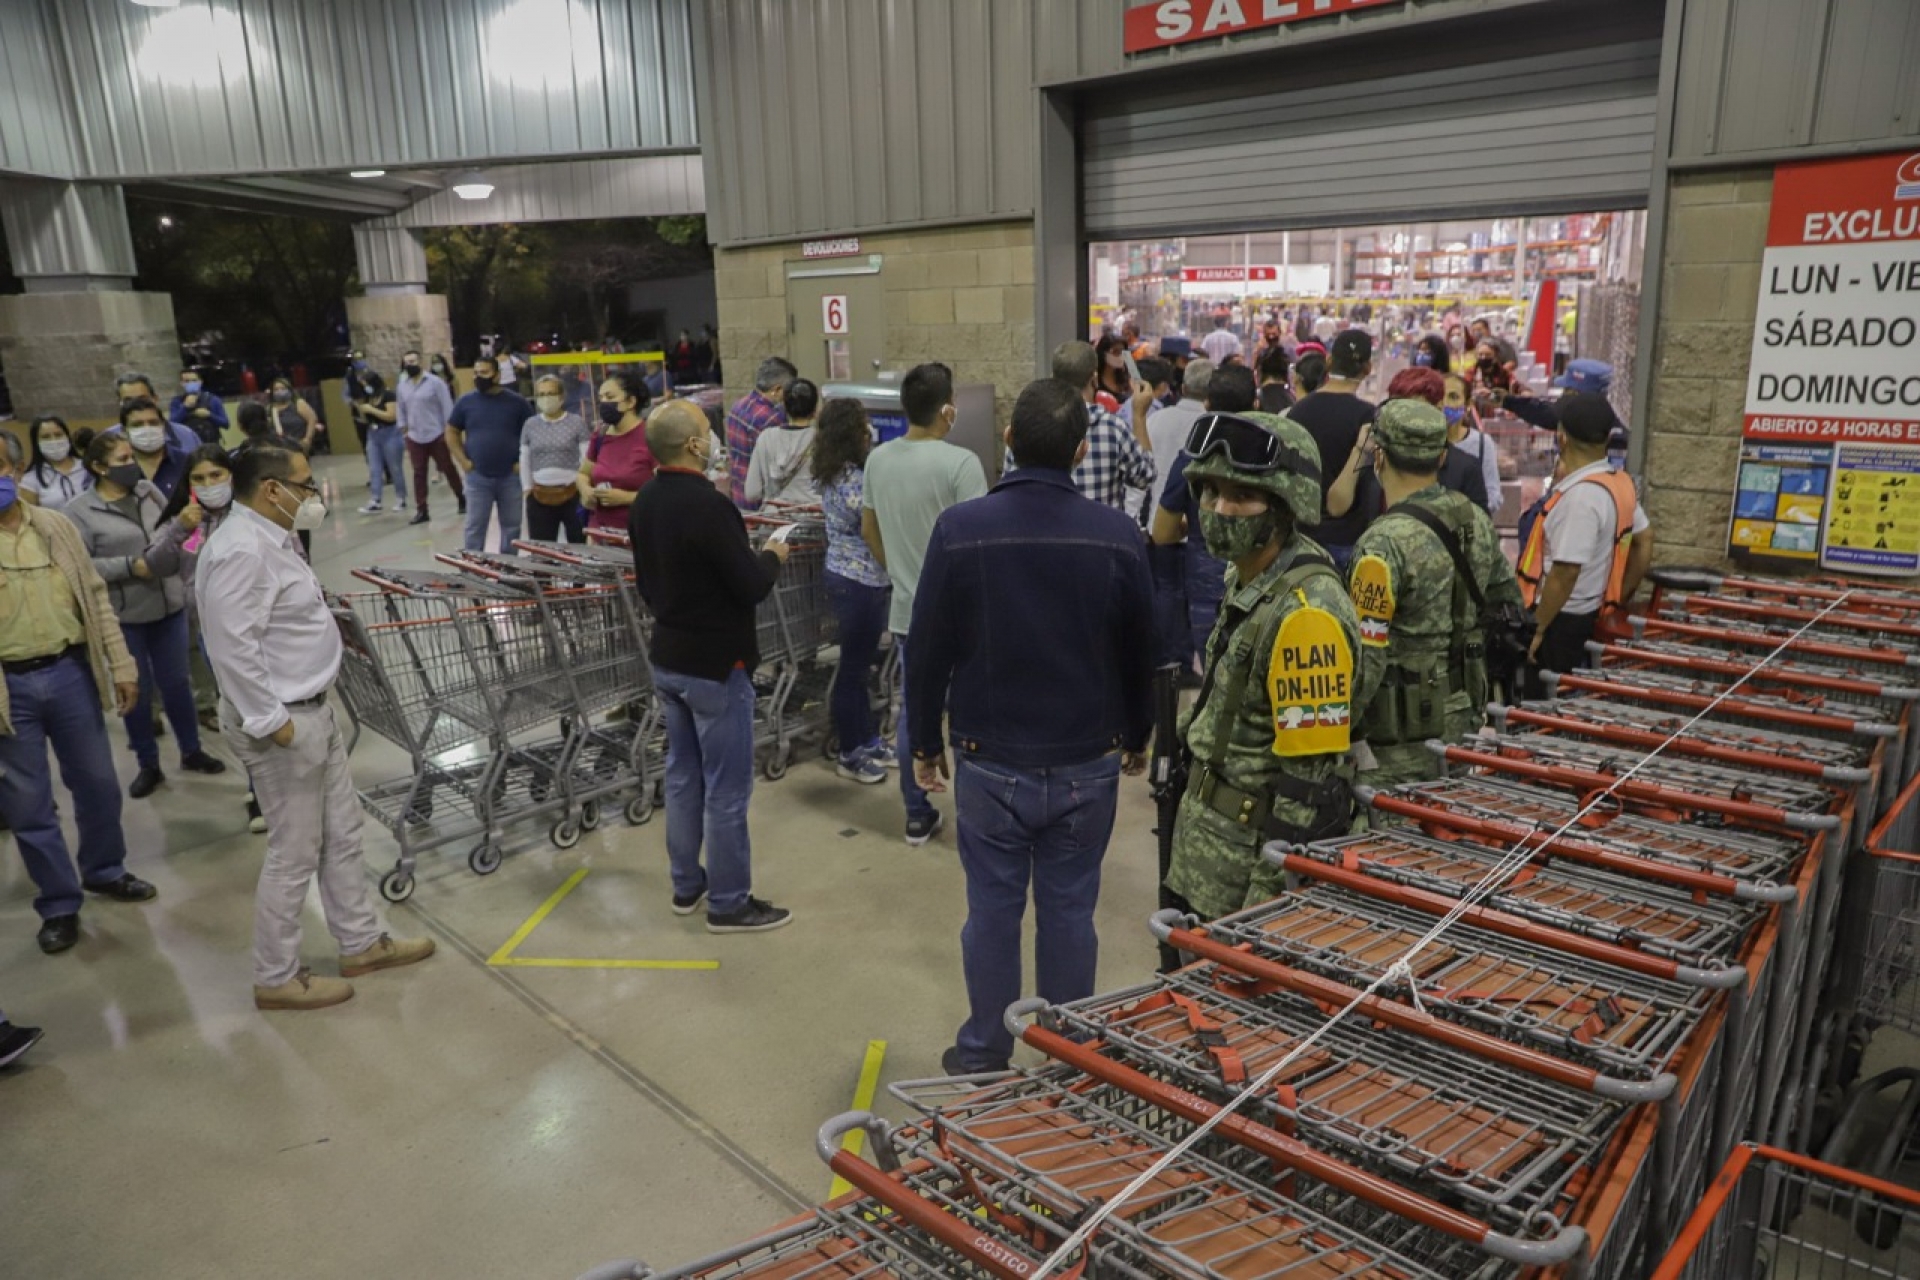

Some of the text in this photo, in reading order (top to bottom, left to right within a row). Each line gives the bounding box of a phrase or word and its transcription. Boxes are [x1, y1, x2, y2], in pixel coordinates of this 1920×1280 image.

[1803, 206, 1920, 242] EXCLU
[803, 238, 859, 256] DEVOLUCIONES
[1196, 267, 1245, 281] FARMACIA
[1770, 263, 1840, 294] LUN
[828, 298, 842, 330] 6
[1763, 311, 1917, 347] SÁBADO
[1750, 417, 1920, 440] ABIERTO 24 HORAS E
[1352, 577, 1386, 600] PLAN
[1282, 643, 1337, 672] PLAN
[1276, 673, 1346, 702] DN-III-E
[974, 1236, 1029, 1274] COSTCO
